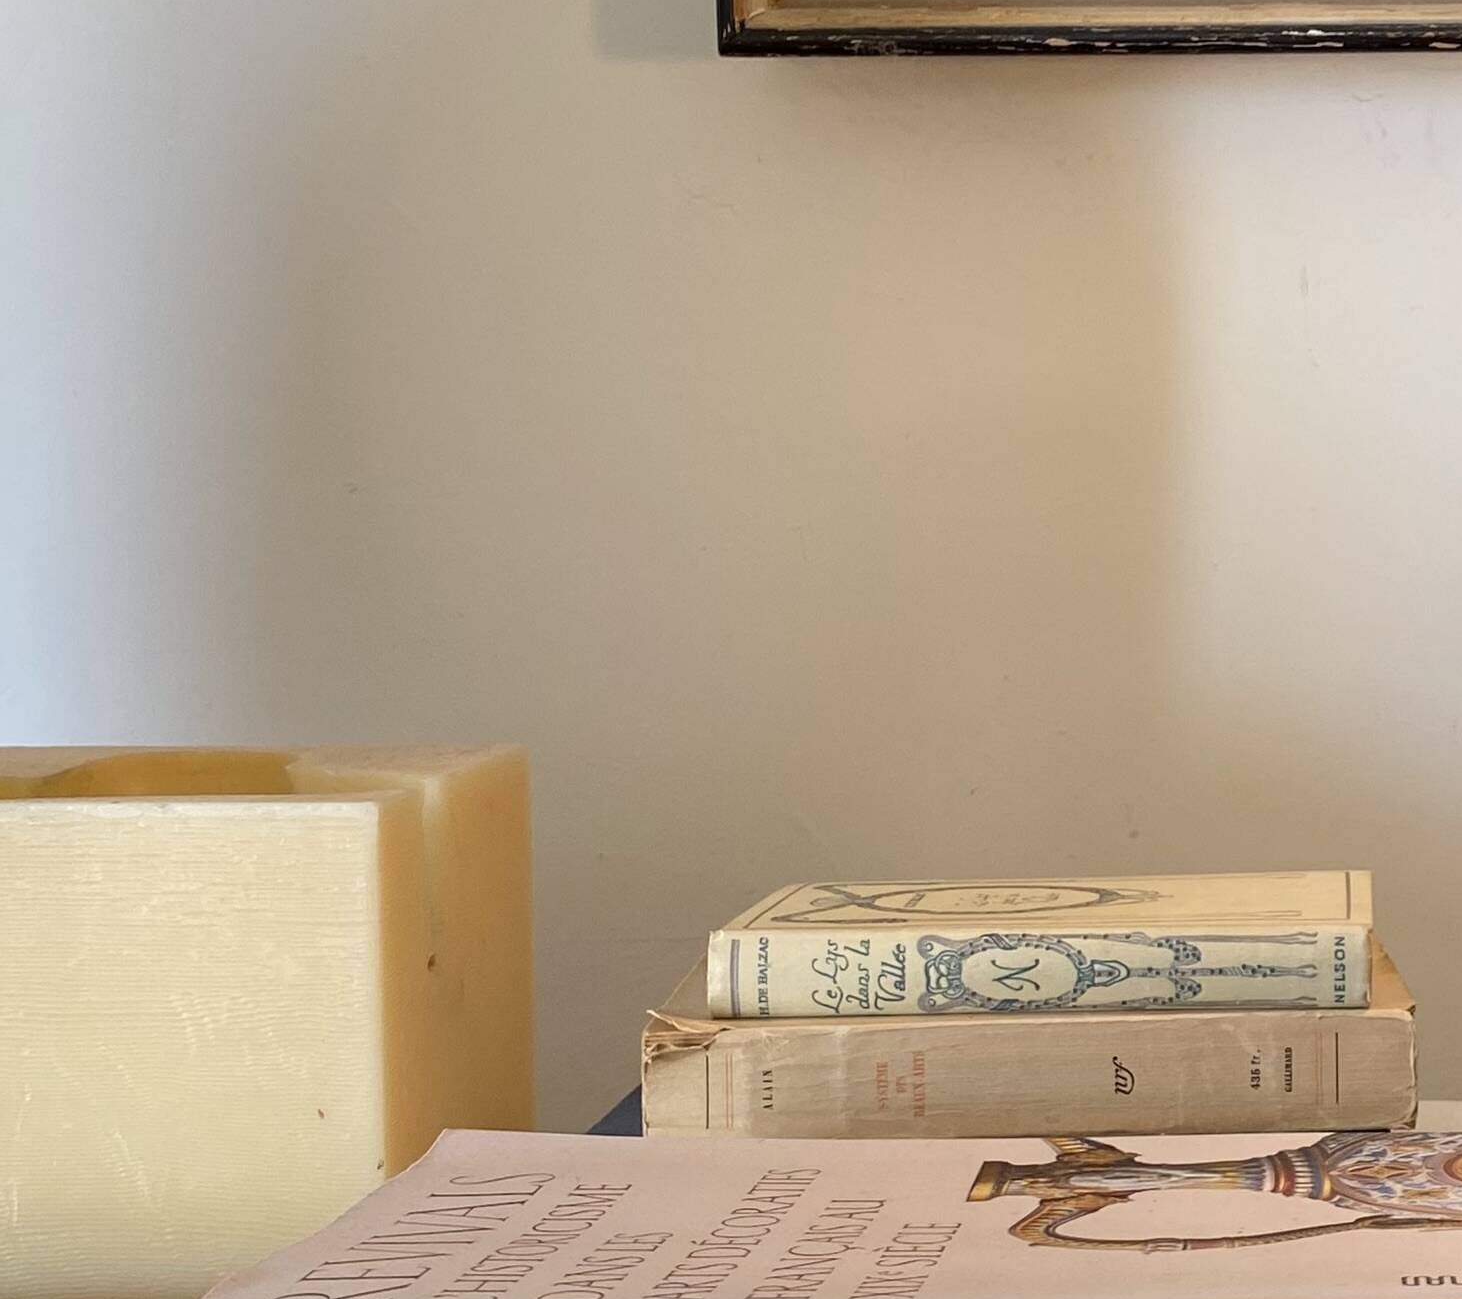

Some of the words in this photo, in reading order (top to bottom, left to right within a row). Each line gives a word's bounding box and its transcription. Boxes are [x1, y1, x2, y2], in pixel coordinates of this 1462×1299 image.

[757, 936, 770, 985] BALZAC
[811, 939, 849, 984] Lys
[843, 938, 871, 957] la
[1333, 935, 1346, 1003] NELSON
[811, 986, 844, 1014] Le
[845, 963, 871, 1010] dans
[762, 1069, 774, 1110] ALAIN
[1112, 1055, 1135, 1095] nrf
[1284, 1046, 1293, 1092] GALLIMARD
[687, 1168, 823, 1259] DÉCORATIFS
[819, 1199, 888, 1222] AU
[593, 1231, 674, 1252] LES
[872, 1222, 962, 1268] SIÈCLE
